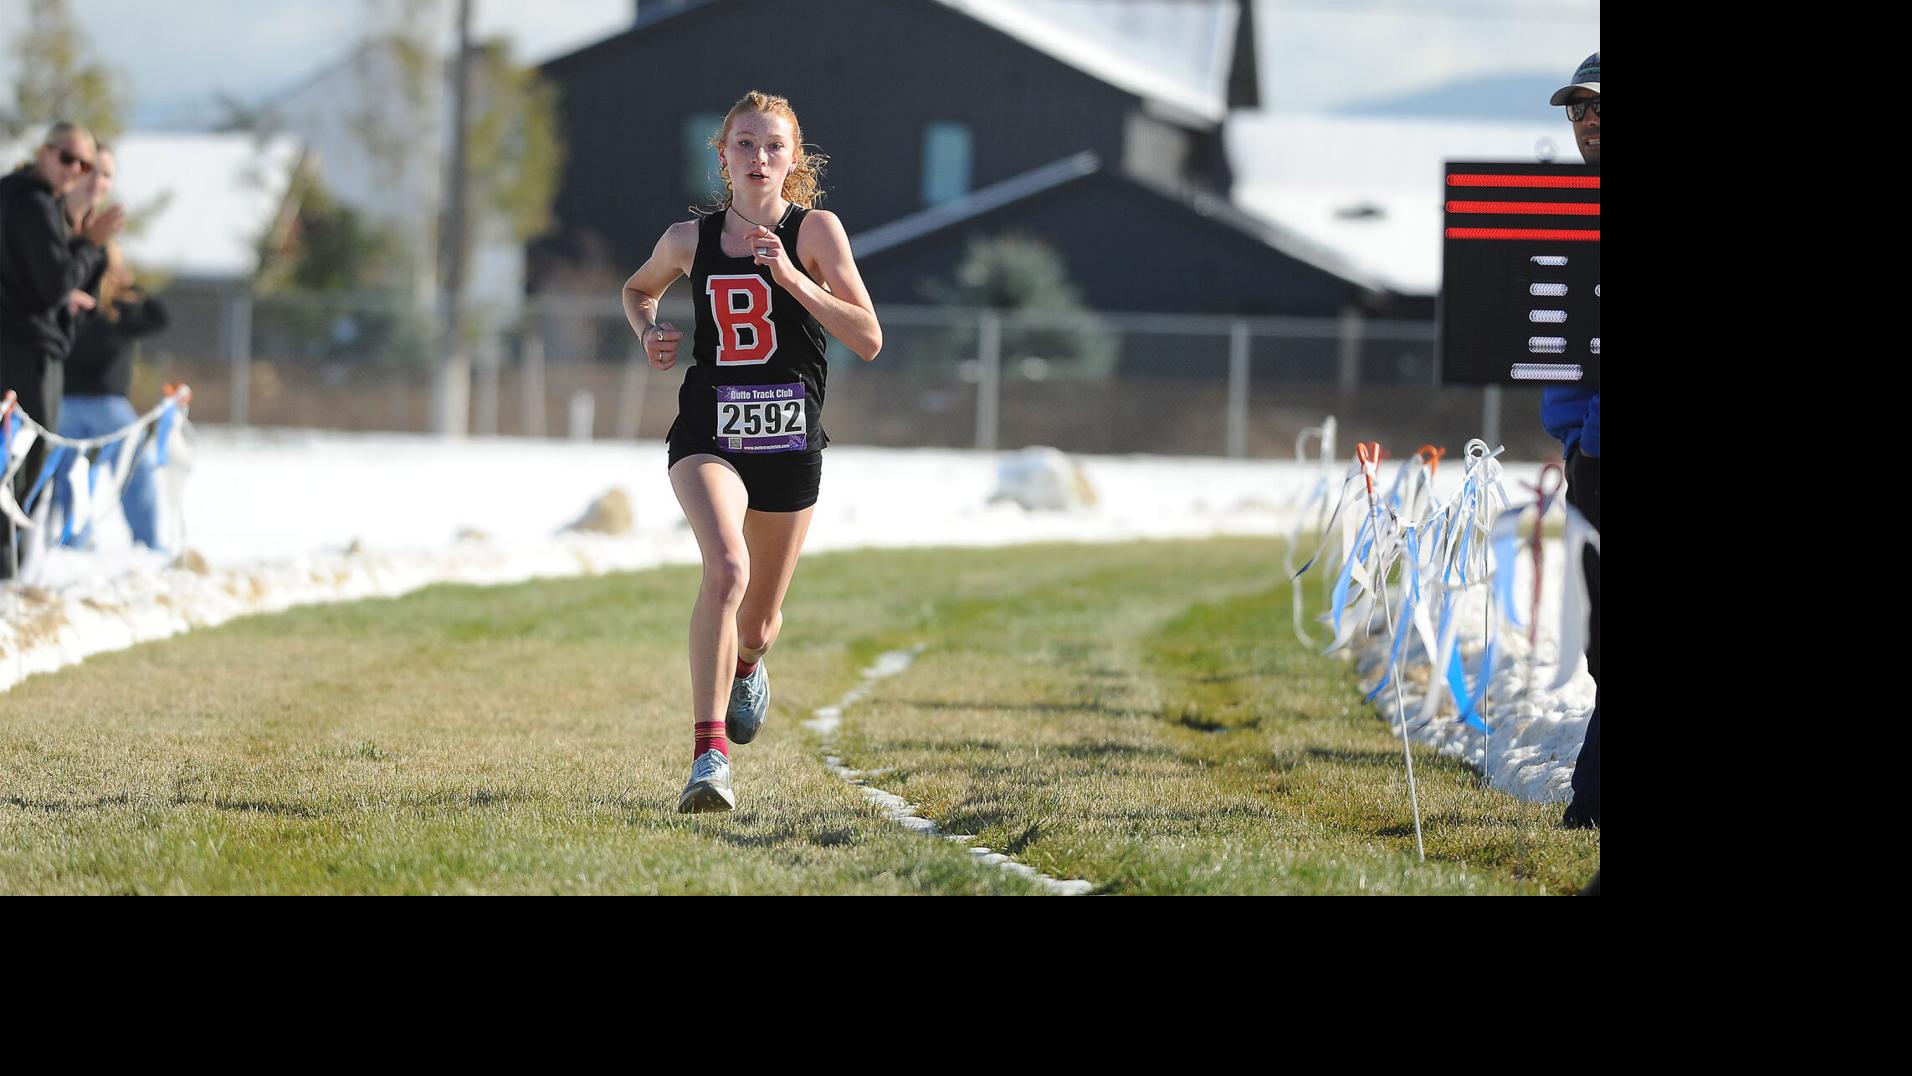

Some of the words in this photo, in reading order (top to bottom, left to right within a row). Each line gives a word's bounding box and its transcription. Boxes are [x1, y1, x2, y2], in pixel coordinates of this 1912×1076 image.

[705, 273, 778, 366] B
[730, 390, 751, 400] Butte
[752, 389, 775, 399] Track
[776, 388, 793, 398] Club
[722, 401, 802, 435] 2592
